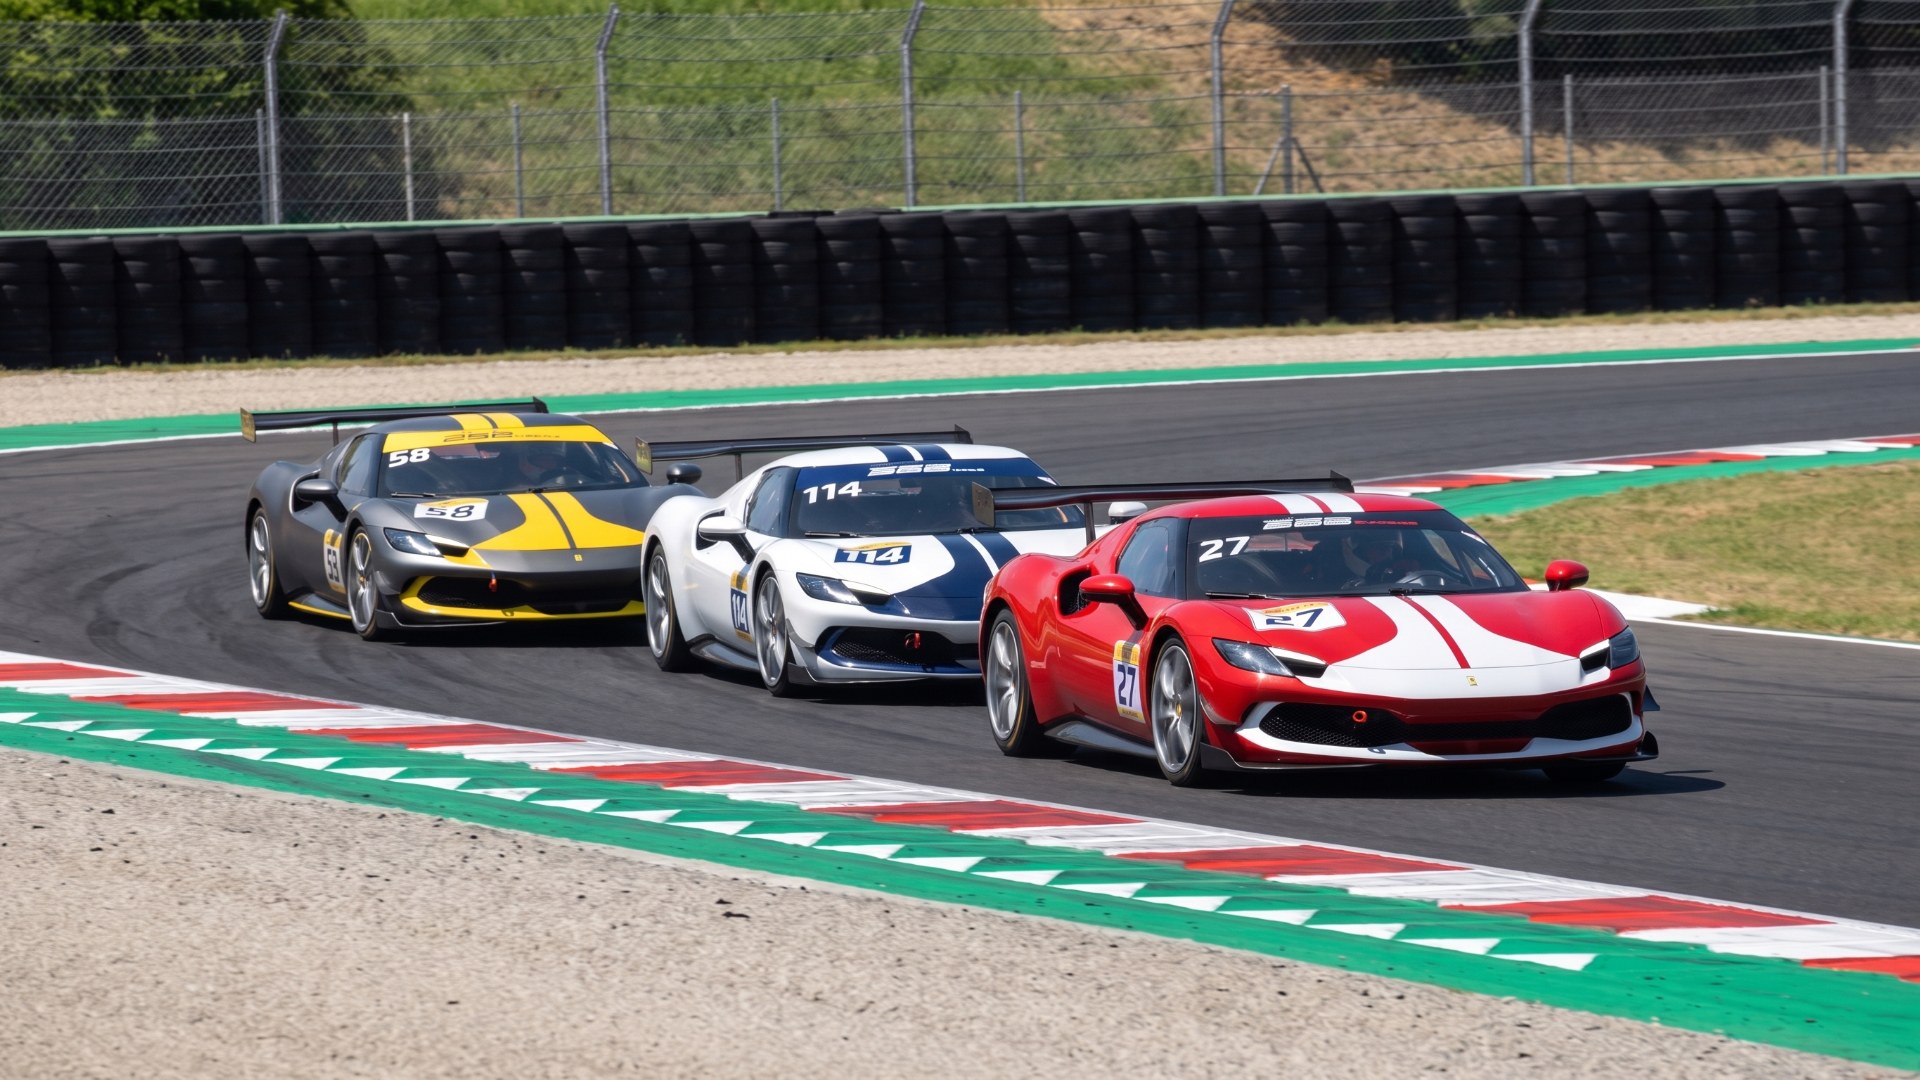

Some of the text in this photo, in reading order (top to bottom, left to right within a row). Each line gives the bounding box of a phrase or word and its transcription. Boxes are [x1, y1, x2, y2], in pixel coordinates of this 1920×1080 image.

[388, 447, 431, 468] 58
[803, 481, 862, 504] 114
[425, 505, 475, 518] 58
[842, 547, 904, 563] 114
[1199, 536, 1250, 563] 27
[732, 593, 748, 631] 114
[1265, 608, 1324, 627] 27
[1117, 664, 1137, 707] 27
